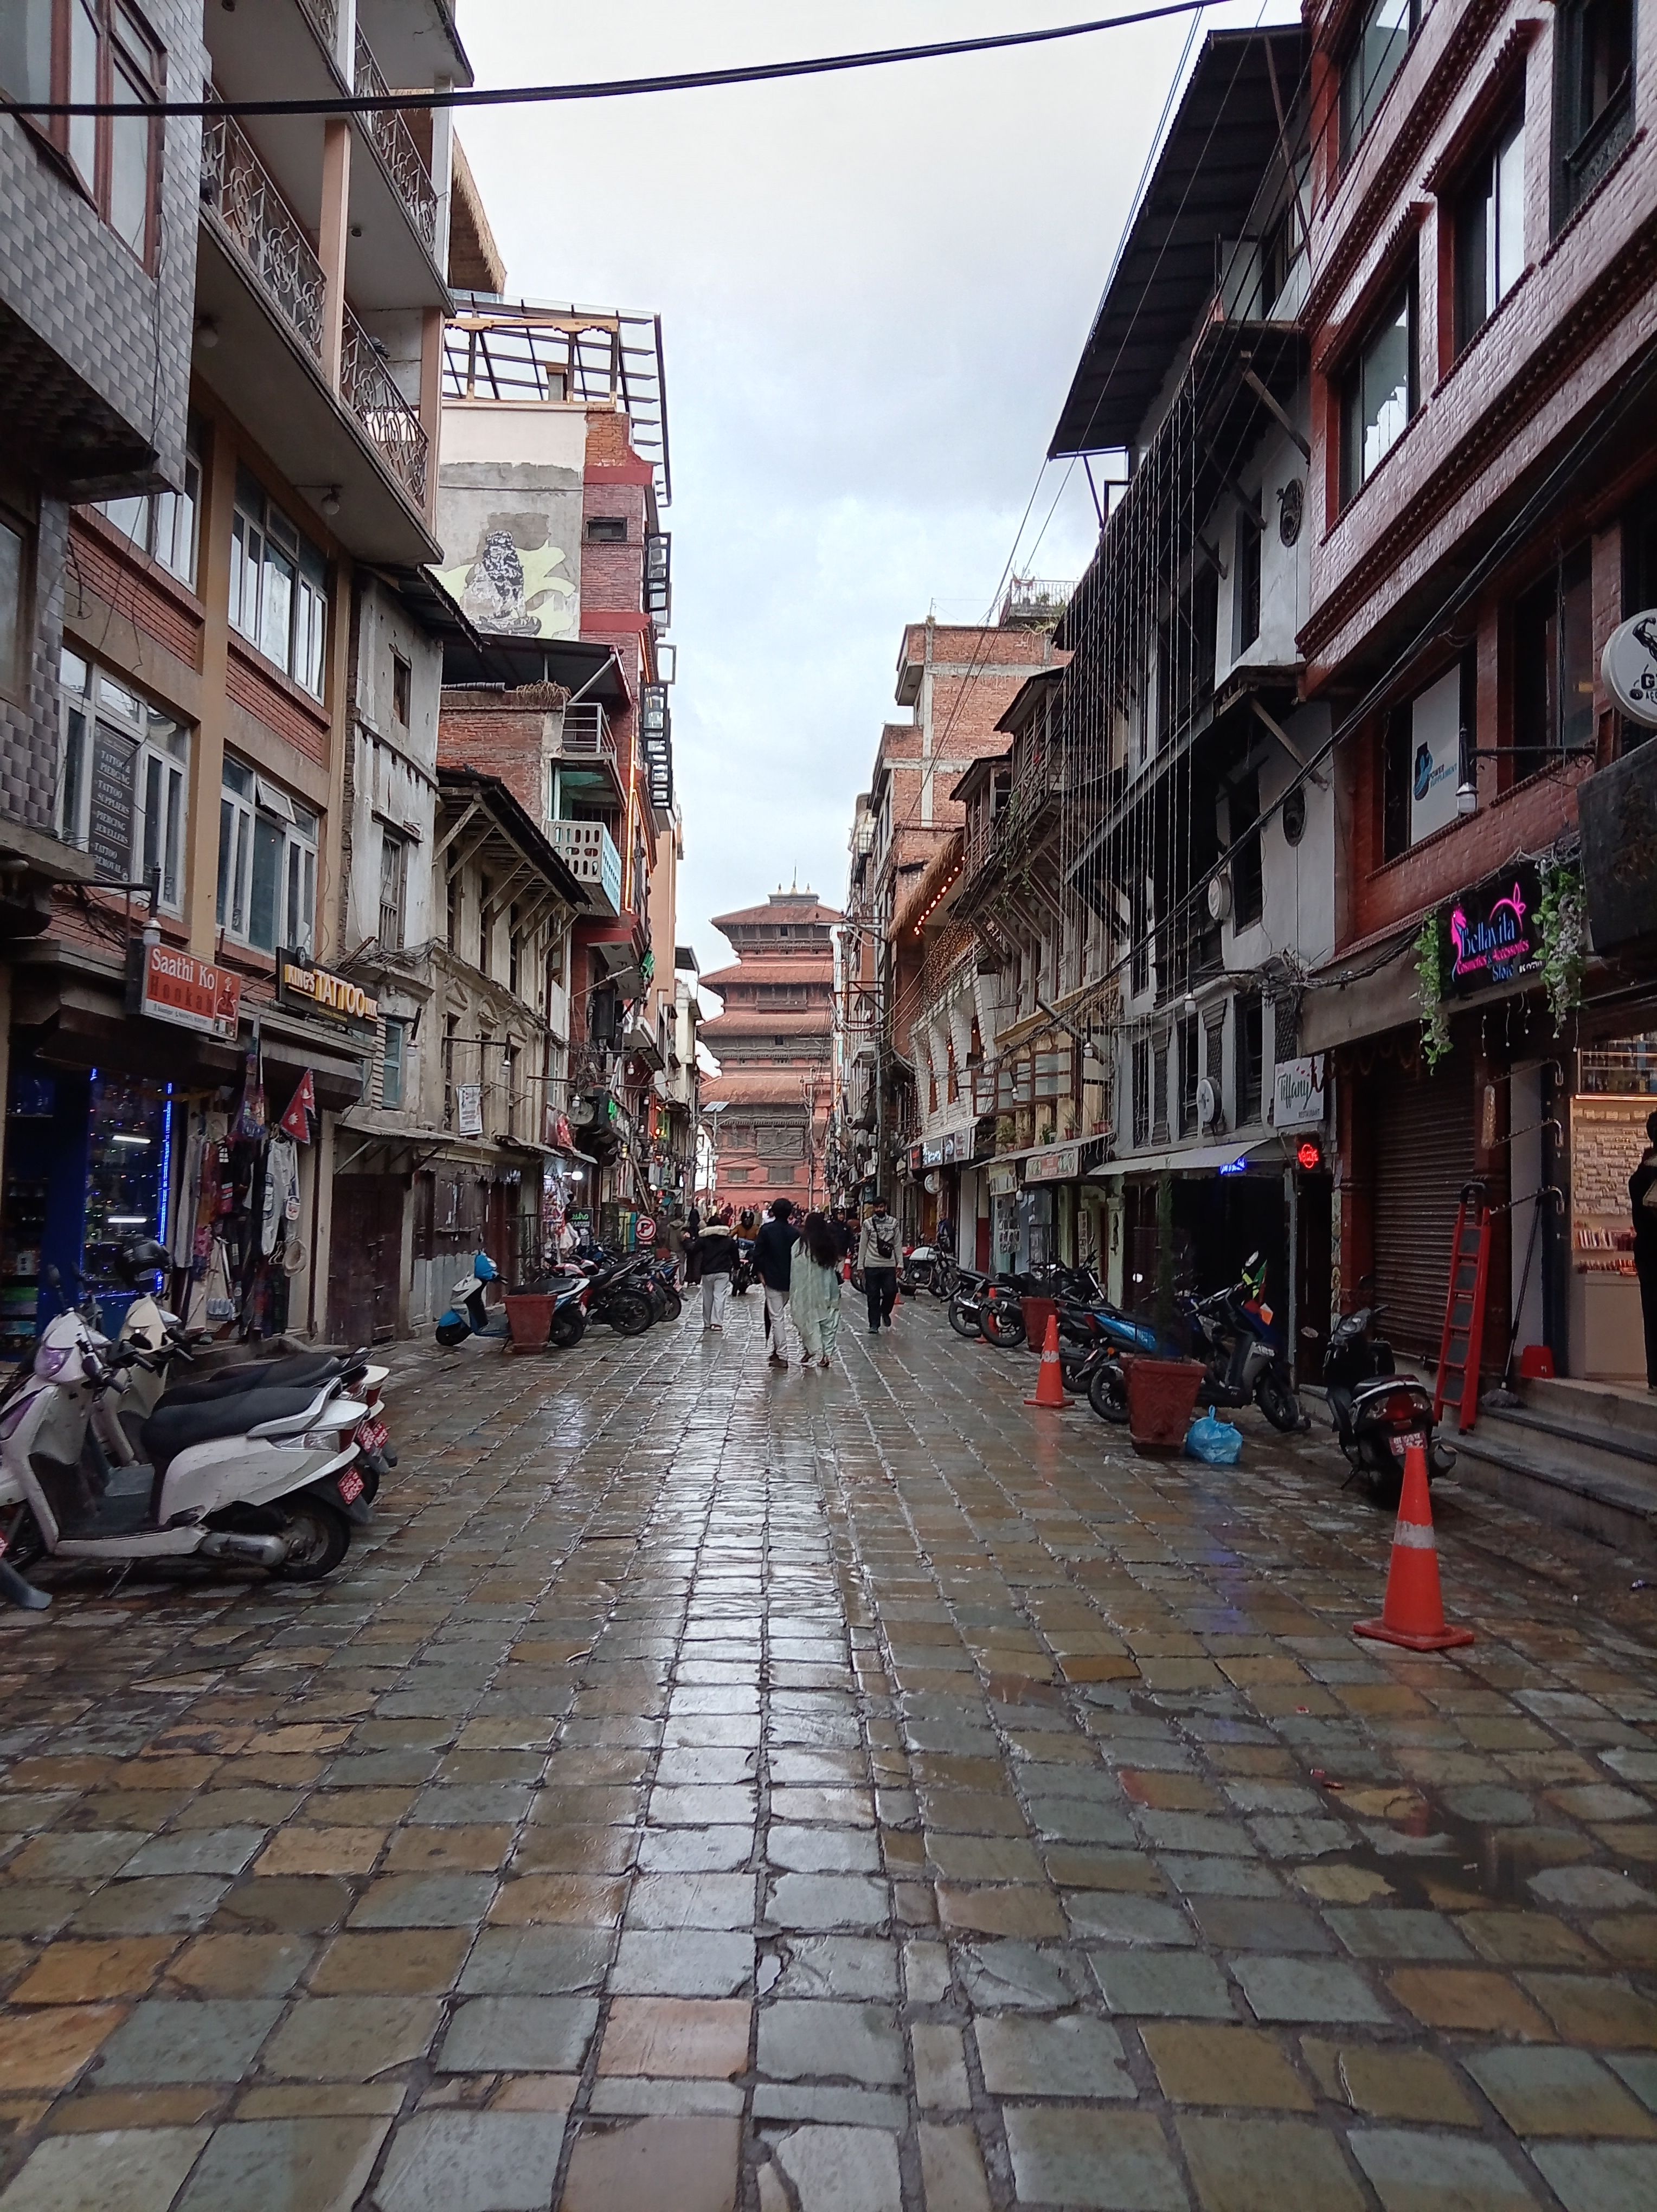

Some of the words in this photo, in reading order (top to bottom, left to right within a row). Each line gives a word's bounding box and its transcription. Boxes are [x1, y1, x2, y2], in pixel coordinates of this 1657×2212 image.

[100, 762, 130, 785] PIERCING
[98, 780, 123, 799] TATTOO
[97, 792, 130, 815] SUPPLIERS
[96, 810, 126, 831] PIERCING
[94, 823, 129, 844] JEWELLERS
[94, 842, 118, 859] TATTOO
[1461, 912, 1515, 958] Bellavita
[151, 948, 194, 982] Saathi
[198, 965, 215, 990] Ko
[150, 975, 213, 1013] Hookah
[313, 969, 365, 1018] TATTOO
[1277, 1073, 1314, 1110] Tiffany
